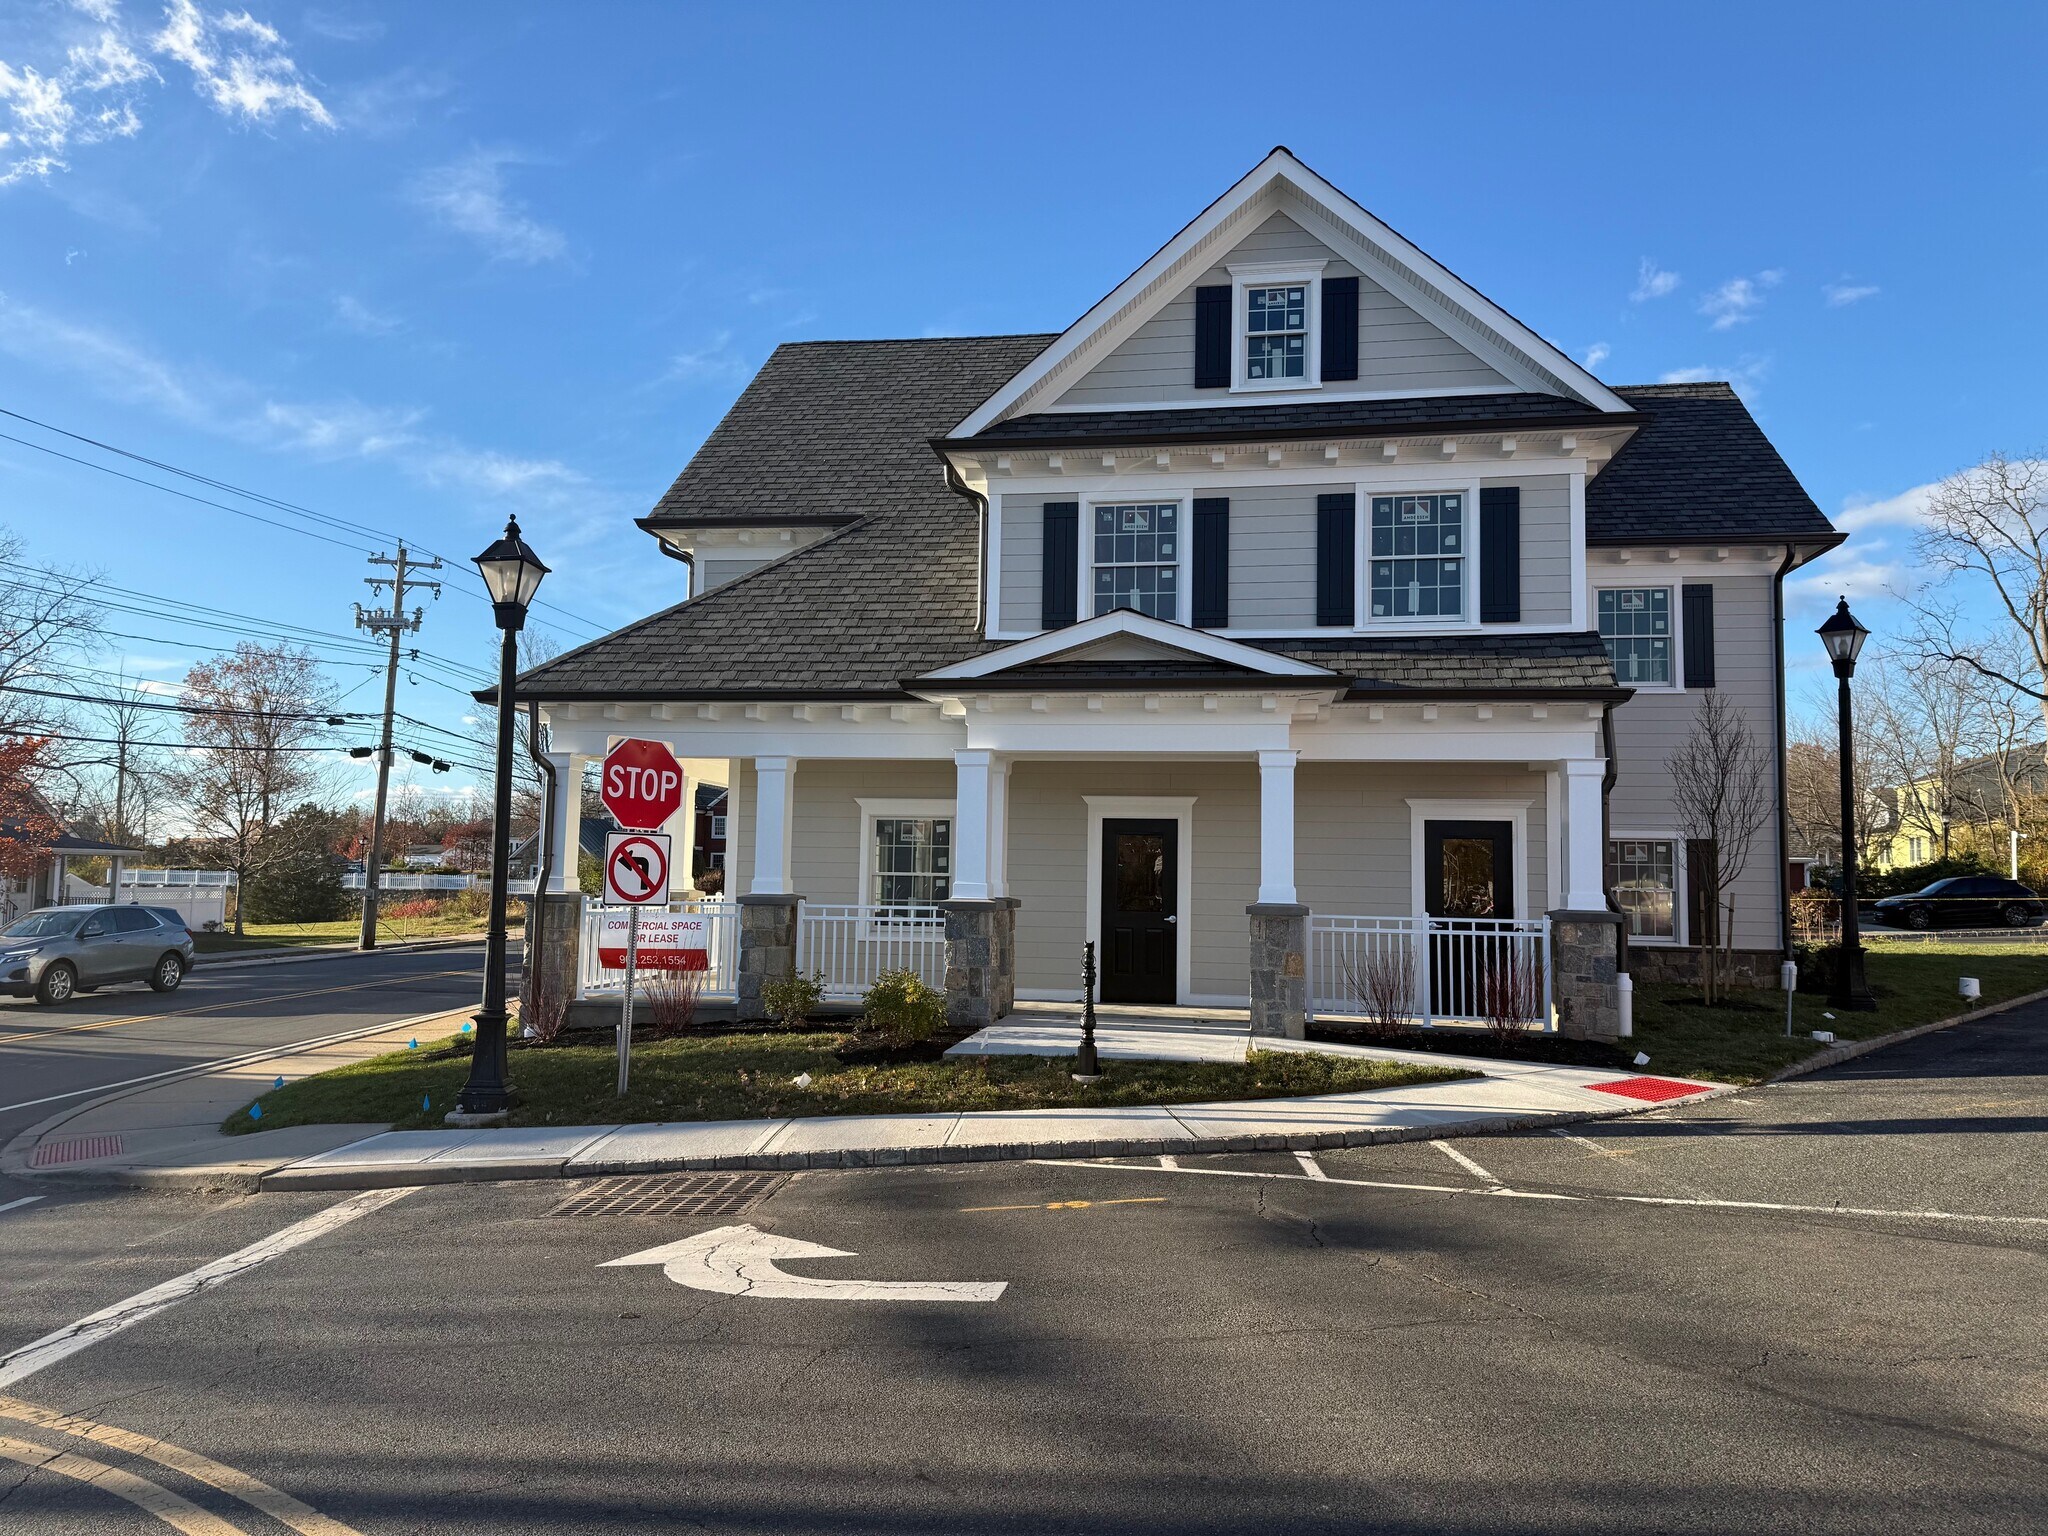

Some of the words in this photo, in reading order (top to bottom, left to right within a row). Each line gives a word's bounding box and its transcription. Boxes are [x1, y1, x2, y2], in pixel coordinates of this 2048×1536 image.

[607, 764, 678, 802] STOP
[608, 921, 668, 930] COMERCIAL
[671, 921, 702, 930] SPACE
[648, 934, 679, 943] LEASE
[619, 954, 687, 965] 9.252.1554
